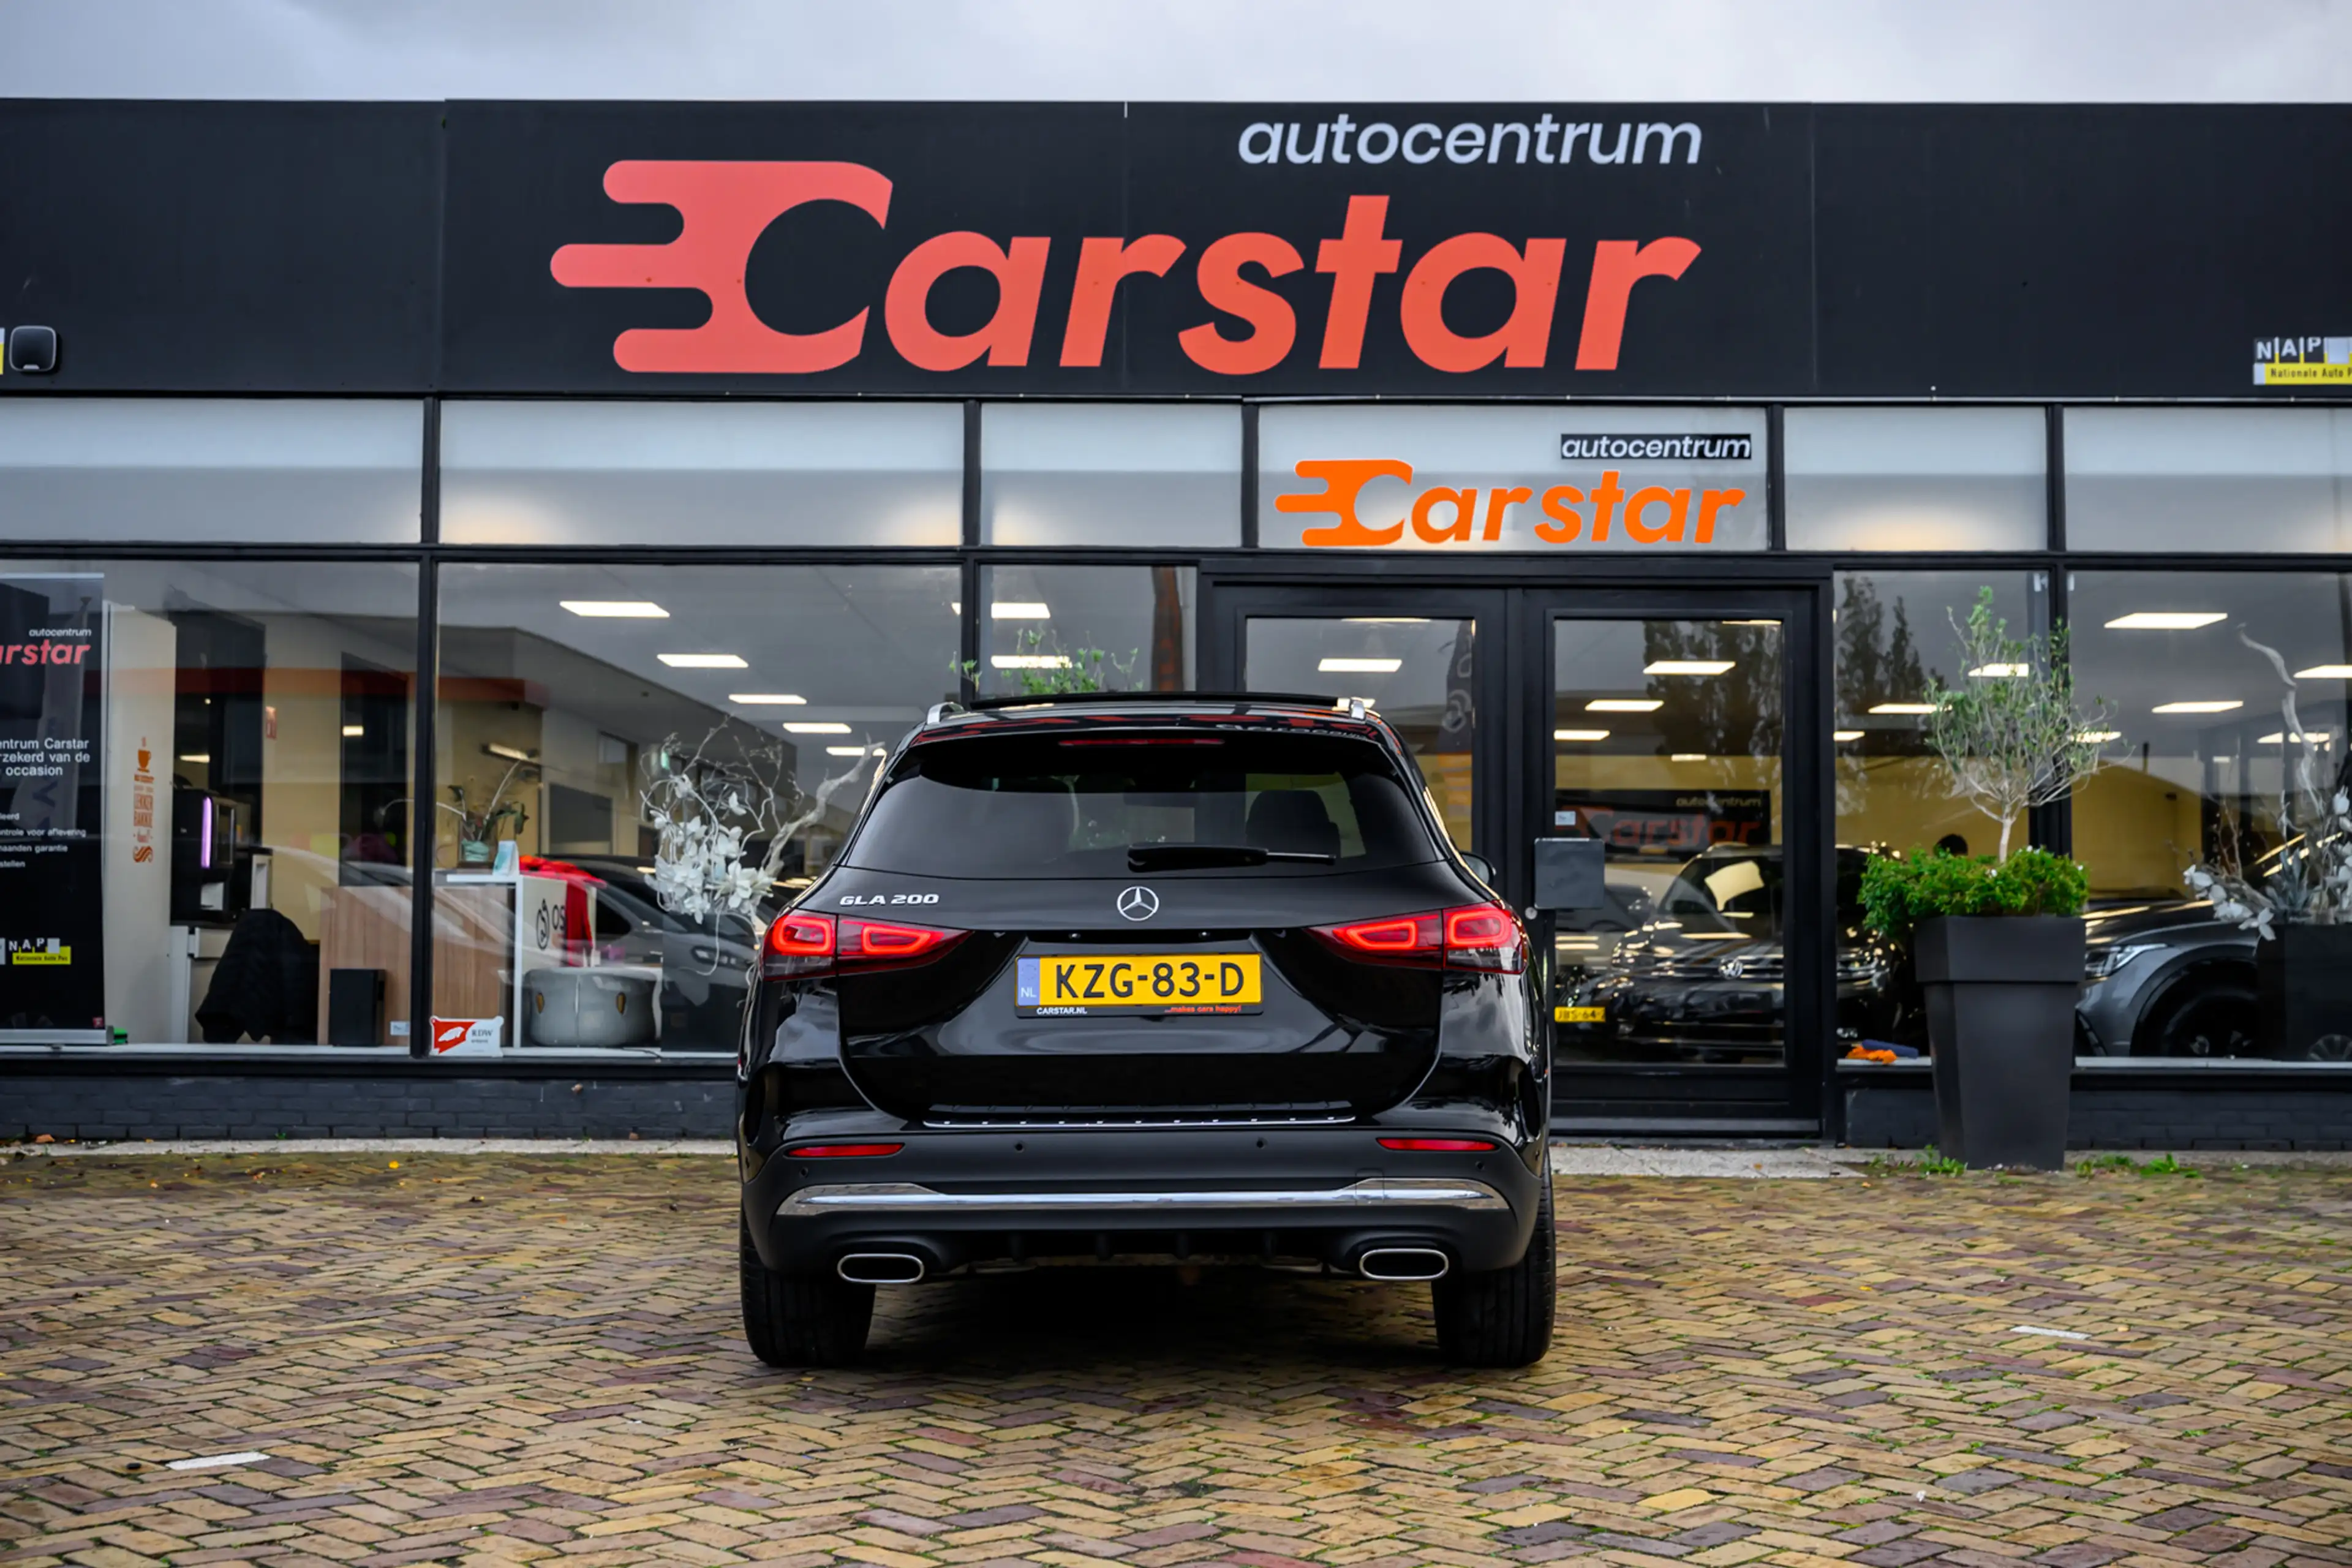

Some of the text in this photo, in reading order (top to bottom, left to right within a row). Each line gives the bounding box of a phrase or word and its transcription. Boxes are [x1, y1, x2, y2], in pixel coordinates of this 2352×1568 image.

[1238, 114, 1702, 165] autocentrum
[551, 160, 1702, 374] Carstar
[2271, 369, 2317, 378] Nationale
[2322, 368, 2344, 378] Auto
[1562, 436, 1750, 458] autocentrum
[1275, 459, 1746, 547] Carstar
[29, 628, 91, 636] autocentrum
[0, 639, 91, 665] rstar
[44, 737, 89, 750] Carstar
[49, 753, 70, 763] van
[75, 752, 91, 763] de
[6, 764, 63, 777] occasion
[48, 828, 86, 838] aflevering
[34, 845, 68, 854] garantie
[840, 894, 939, 905] GLA 200
[9, 938, 45, 951] NAP
[1055, 962, 1245, 998] KZG-83-D
[1020, 986, 1037, 998] NL
[1036, 1006, 1087, 1015] CARSTAR.NL
[1215, 1004, 1242, 1013] happy!
